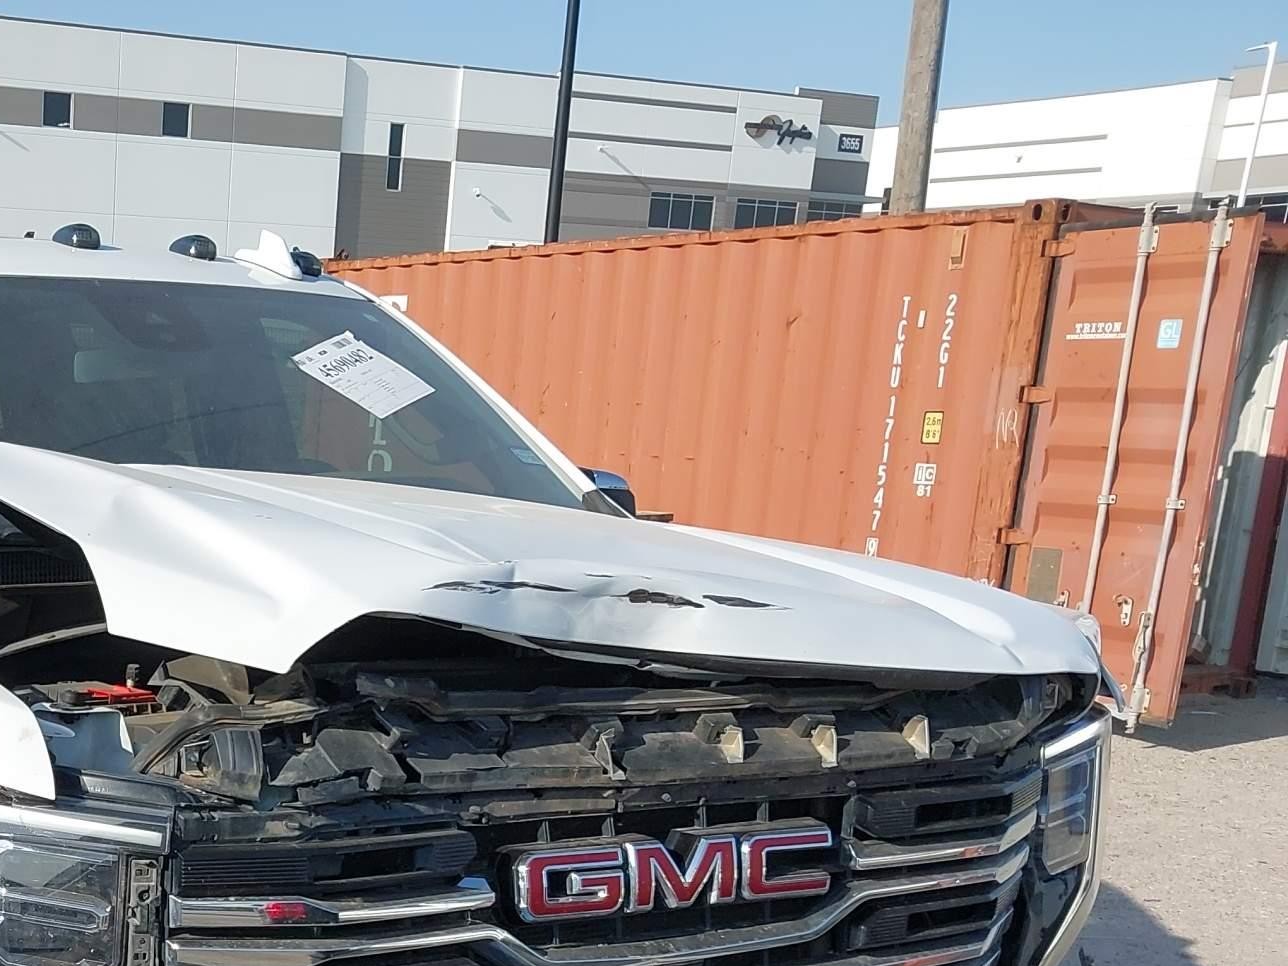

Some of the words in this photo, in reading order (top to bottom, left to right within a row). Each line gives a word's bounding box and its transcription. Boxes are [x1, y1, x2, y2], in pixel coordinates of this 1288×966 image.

[840, 136, 861, 151] 3655
[889, 296, 911, 388] TCKU
[936, 294, 958, 388] 22G1
[1075, 322, 1122, 333] TRITON
[317, 347, 375, 379] 45690482
[871, 395, 896, 531] 171547
[916, 485, 932, 497] 81
[513, 825, 834, 923] GMC
